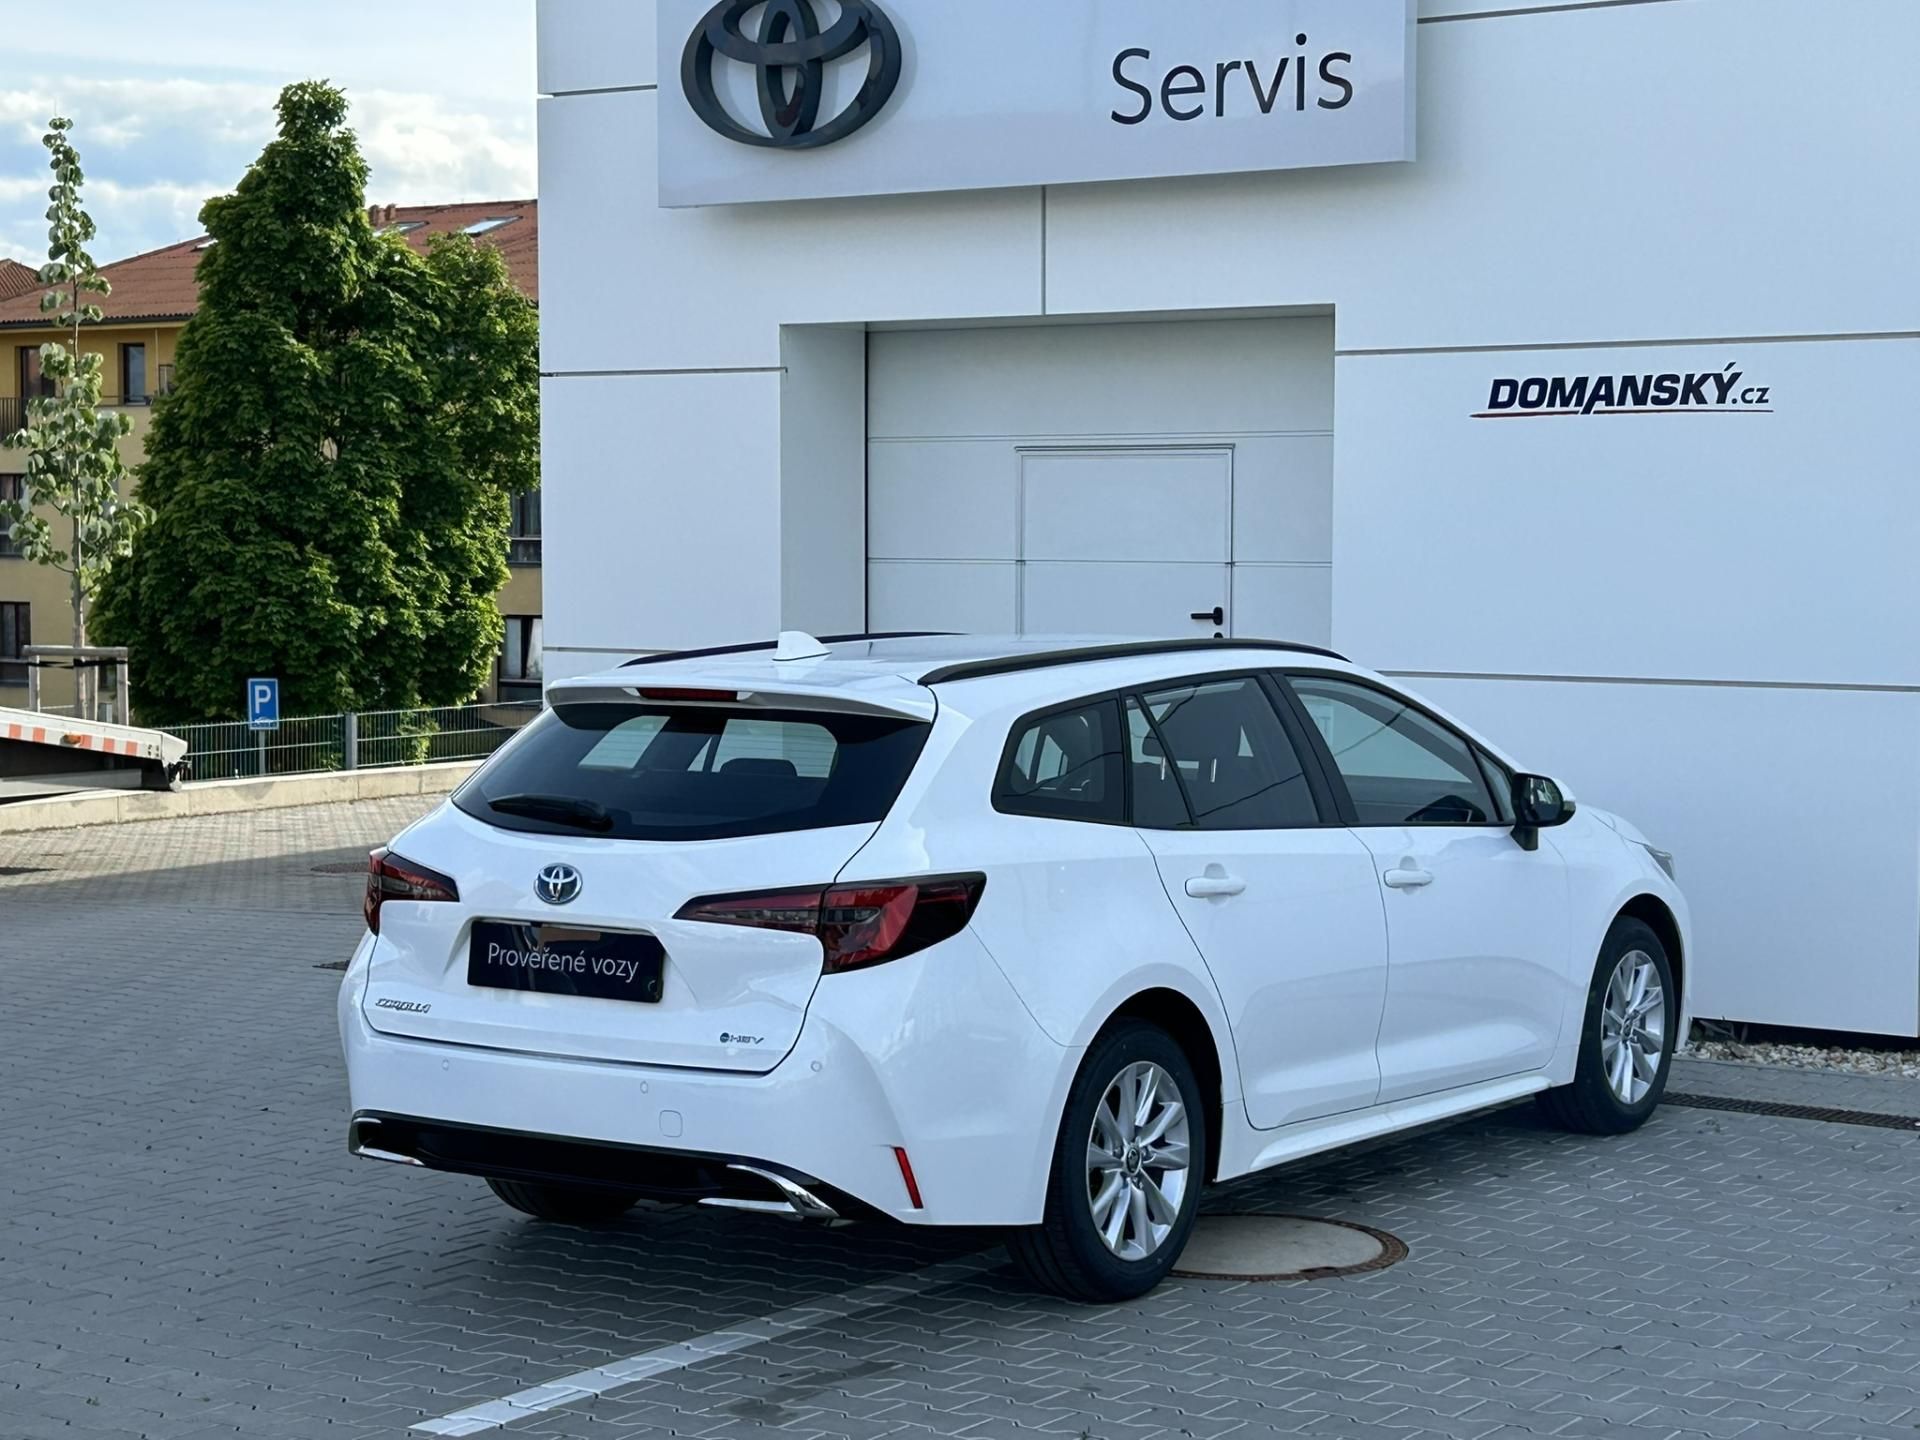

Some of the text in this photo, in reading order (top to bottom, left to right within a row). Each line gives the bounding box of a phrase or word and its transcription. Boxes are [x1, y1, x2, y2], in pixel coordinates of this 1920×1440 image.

[1111, 33, 1354, 125] Servis
[1487, 361, 1770, 415] DOMANSKÝ.cz
[254, 685, 271, 714] P
[487, 942, 639, 983] Prověřené vozy
[375, 998, 432, 1013] COROLLA
